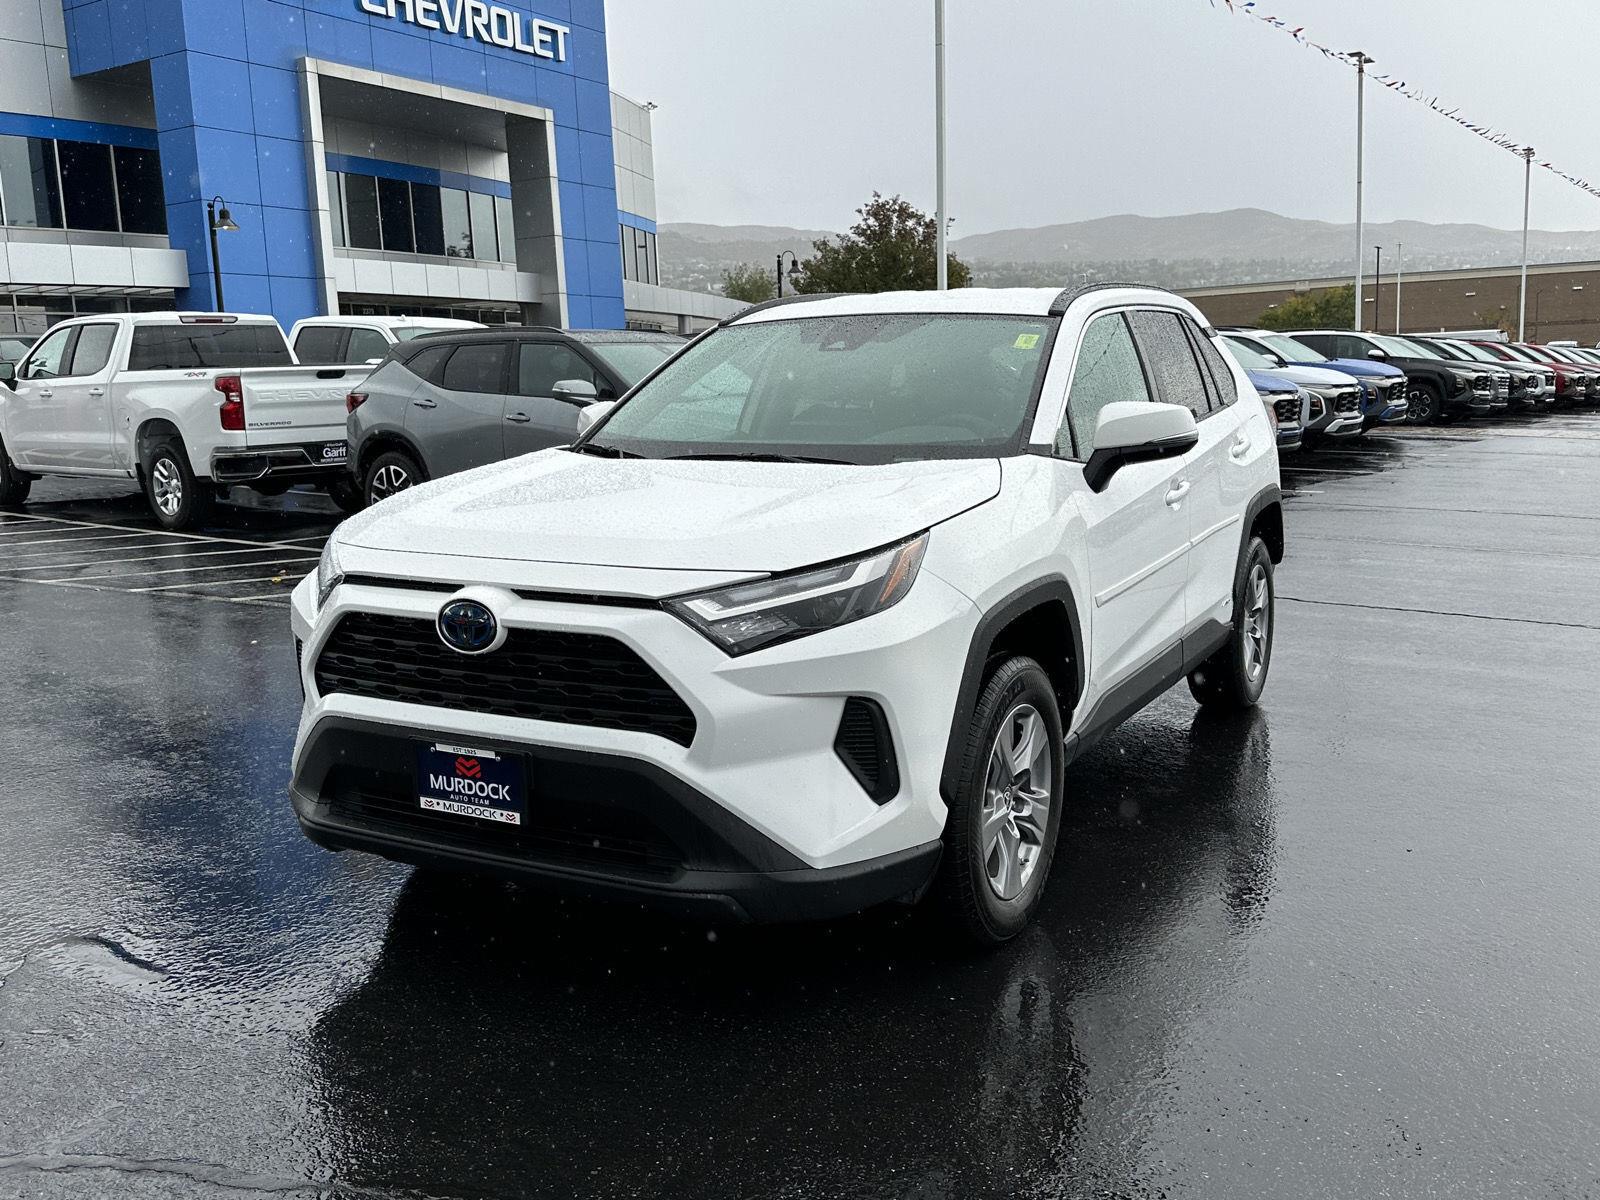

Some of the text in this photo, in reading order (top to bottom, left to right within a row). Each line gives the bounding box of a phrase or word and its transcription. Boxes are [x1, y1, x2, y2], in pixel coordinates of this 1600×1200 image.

[322, 446, 347, 458] Garff
[429, 773, 511, 801] MURDOCK
[471, 797, 490, 805] TEAM
[443, 802, 497, 819] MURDOCK
